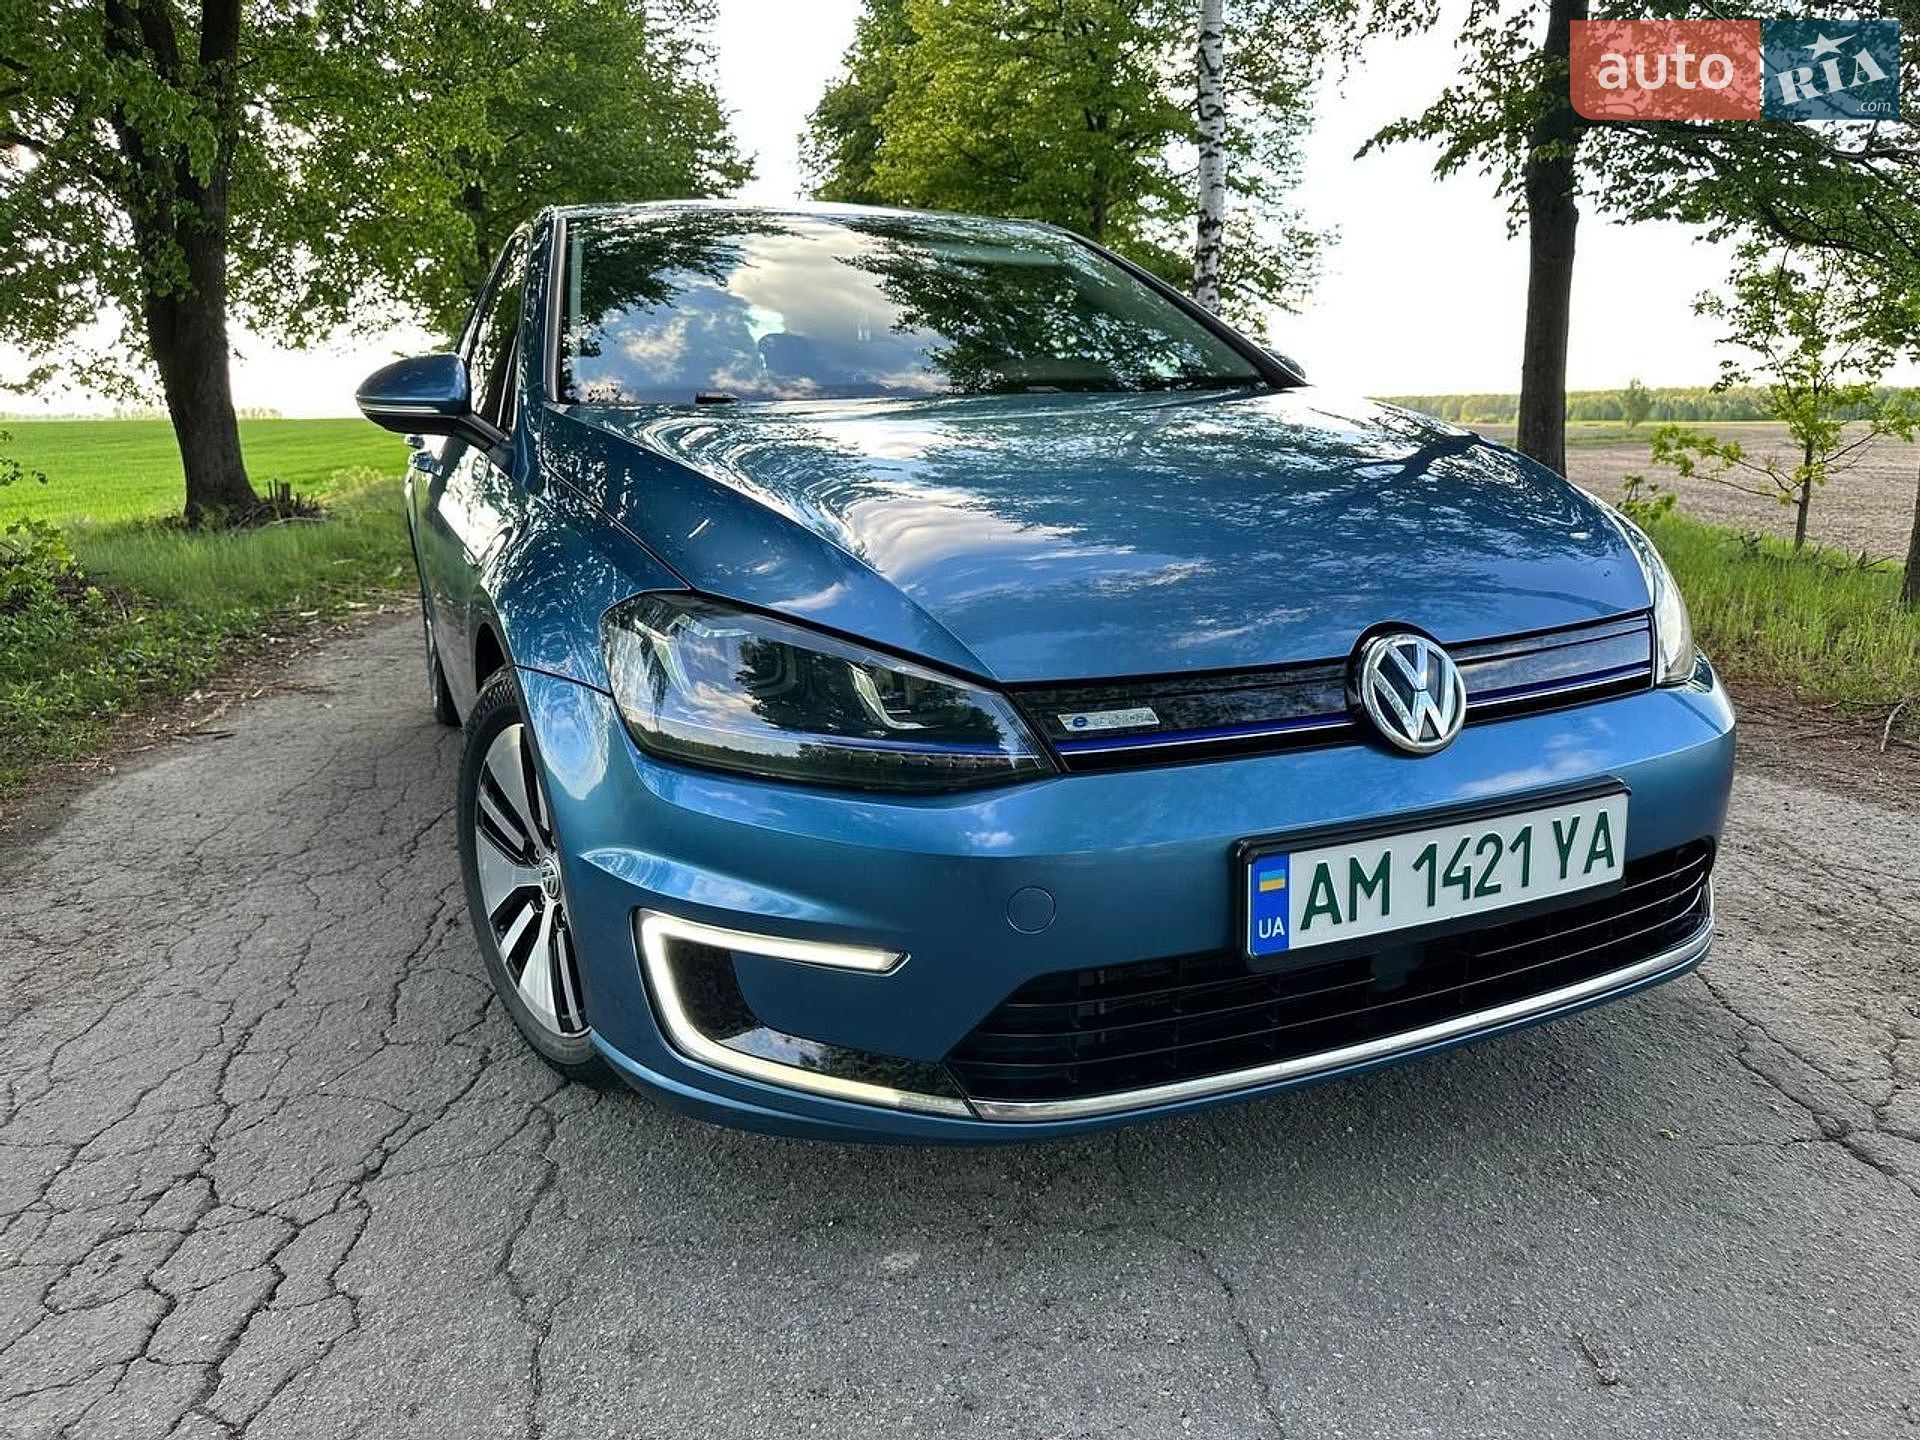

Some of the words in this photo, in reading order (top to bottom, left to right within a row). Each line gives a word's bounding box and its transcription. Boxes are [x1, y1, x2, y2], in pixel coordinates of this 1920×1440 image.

[1300, 850, 1392, 931] AM
[1412, 824, 1533, 908] 1421
[1552, 810, 1615, 880] YA
[1258, 916, 1285, 939] UA
